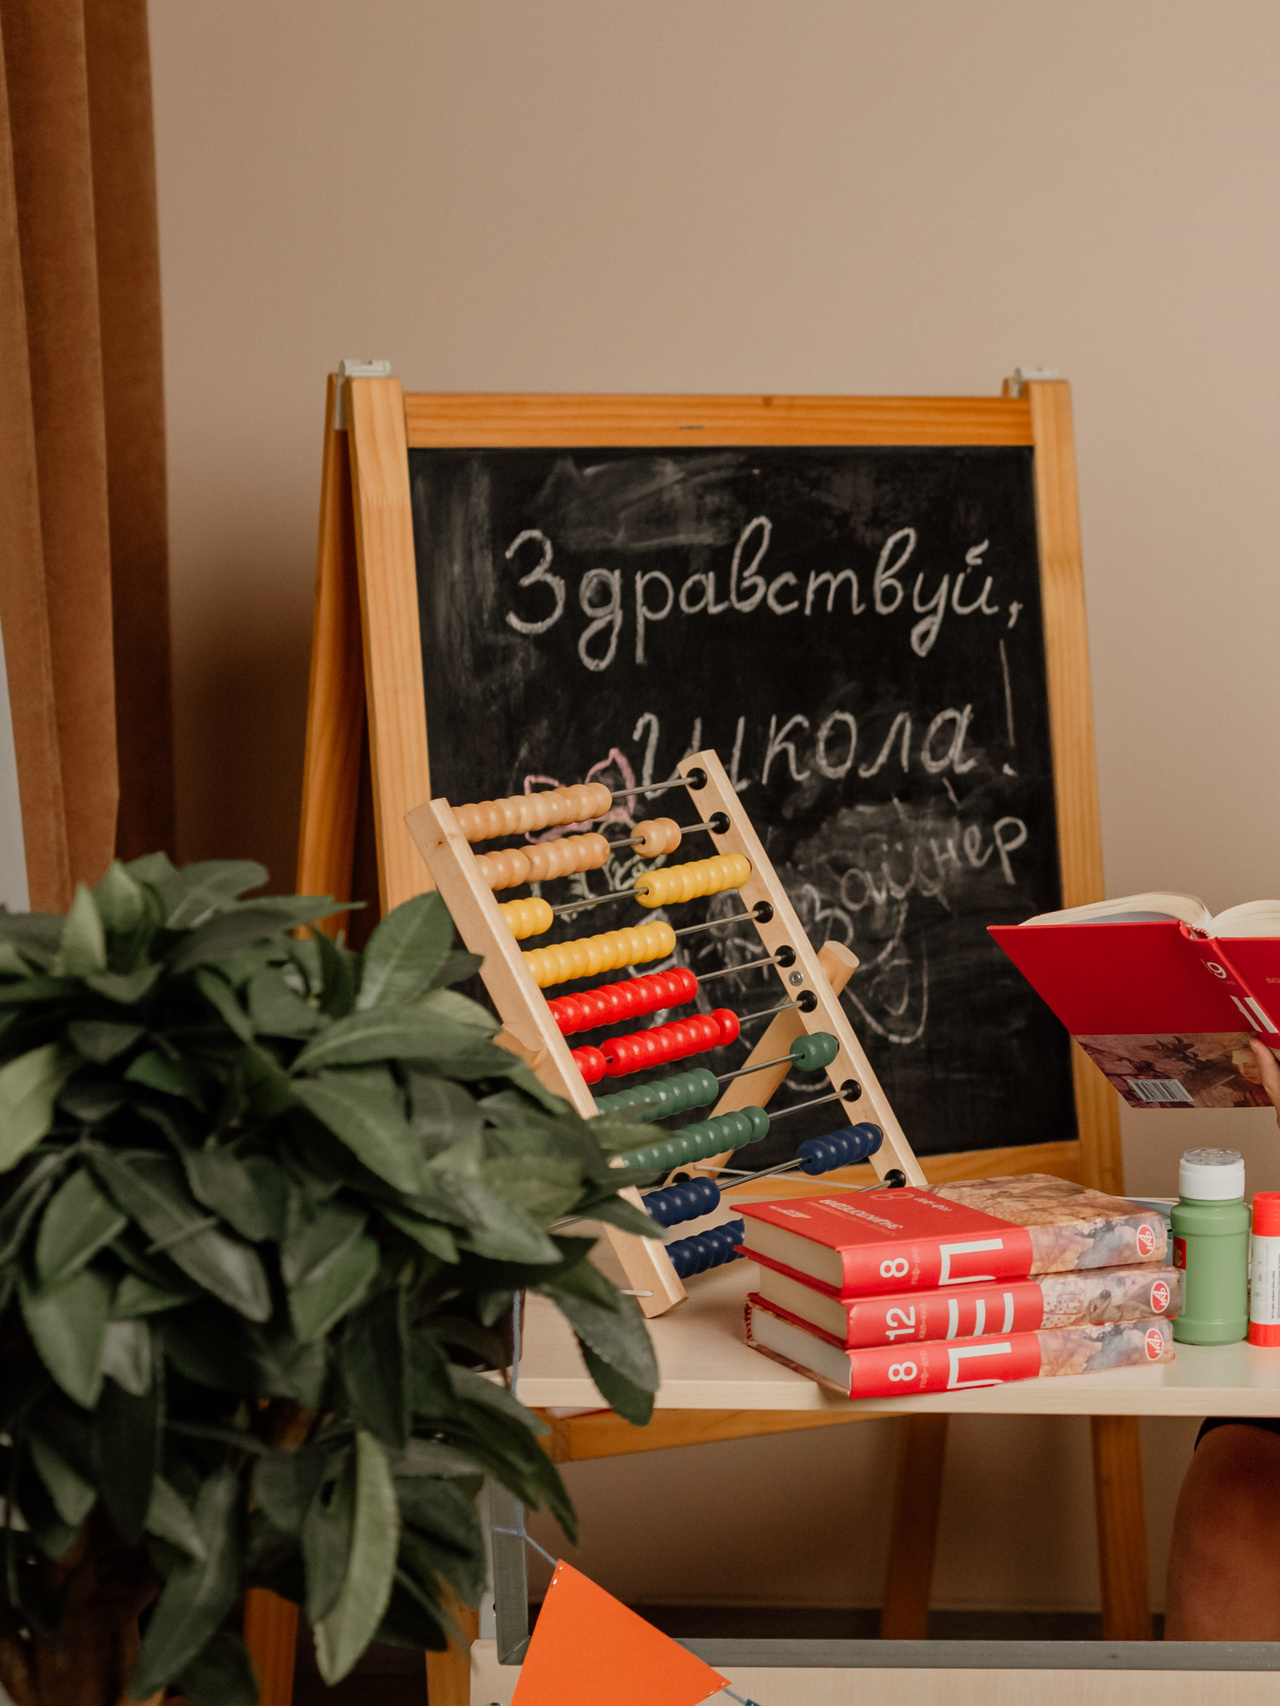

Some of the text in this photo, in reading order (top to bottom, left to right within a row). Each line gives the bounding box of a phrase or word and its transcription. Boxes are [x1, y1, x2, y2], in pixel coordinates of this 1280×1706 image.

[504, 515, 1024, 672] Здравствуй,
[879, 1257, 909, 1278] 8
[885, 1305, 916, 1341] 12
[888, 1361, 918, 1382] 8
